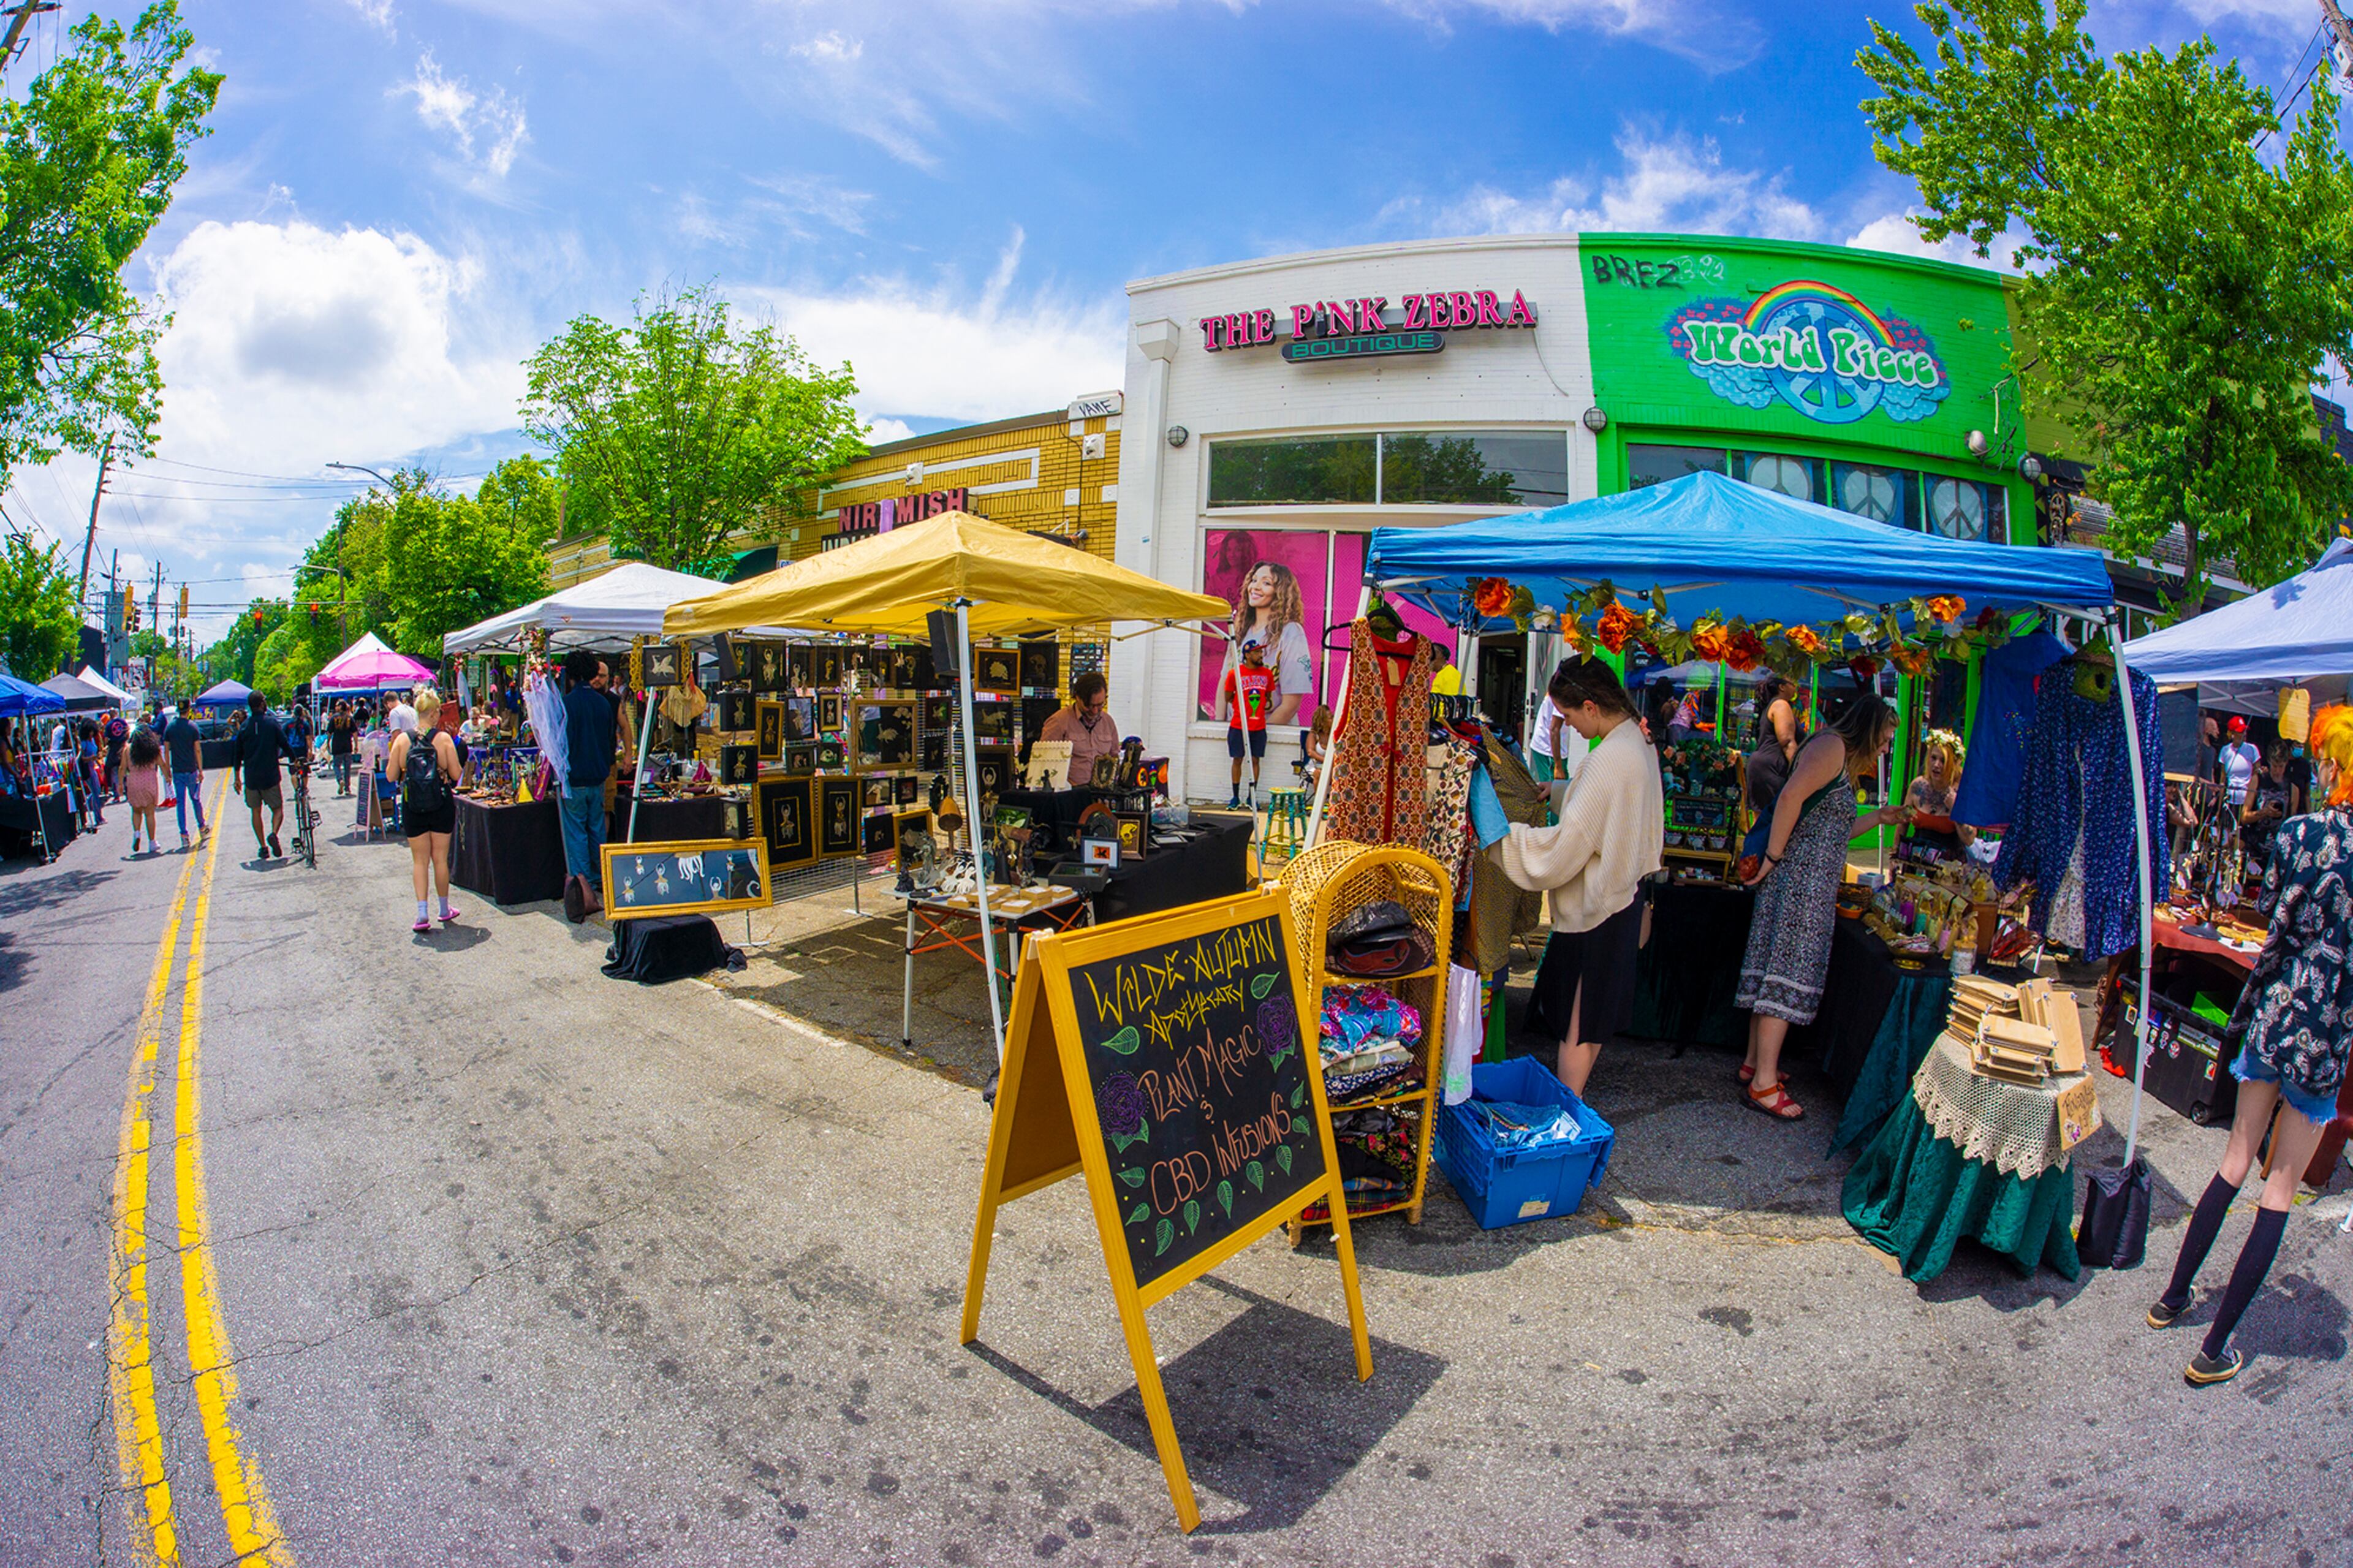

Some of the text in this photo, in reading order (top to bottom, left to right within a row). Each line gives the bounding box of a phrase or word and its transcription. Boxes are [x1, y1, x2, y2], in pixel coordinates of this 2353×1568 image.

[1200, 308, 1275, 352] THE
[1402, 289, 1537, 331] ZEBRA
[1292, 334, 1434, 358] BOUTIQUE
[1683, 320, 1940, 389] World Piece
[839, 487, 968, 532] NIRMISH
[1137, 1025, 1262, 1122] PLANT MAGIC
[1150, 1091, 1292, 1216] CBD INFUSIONS
